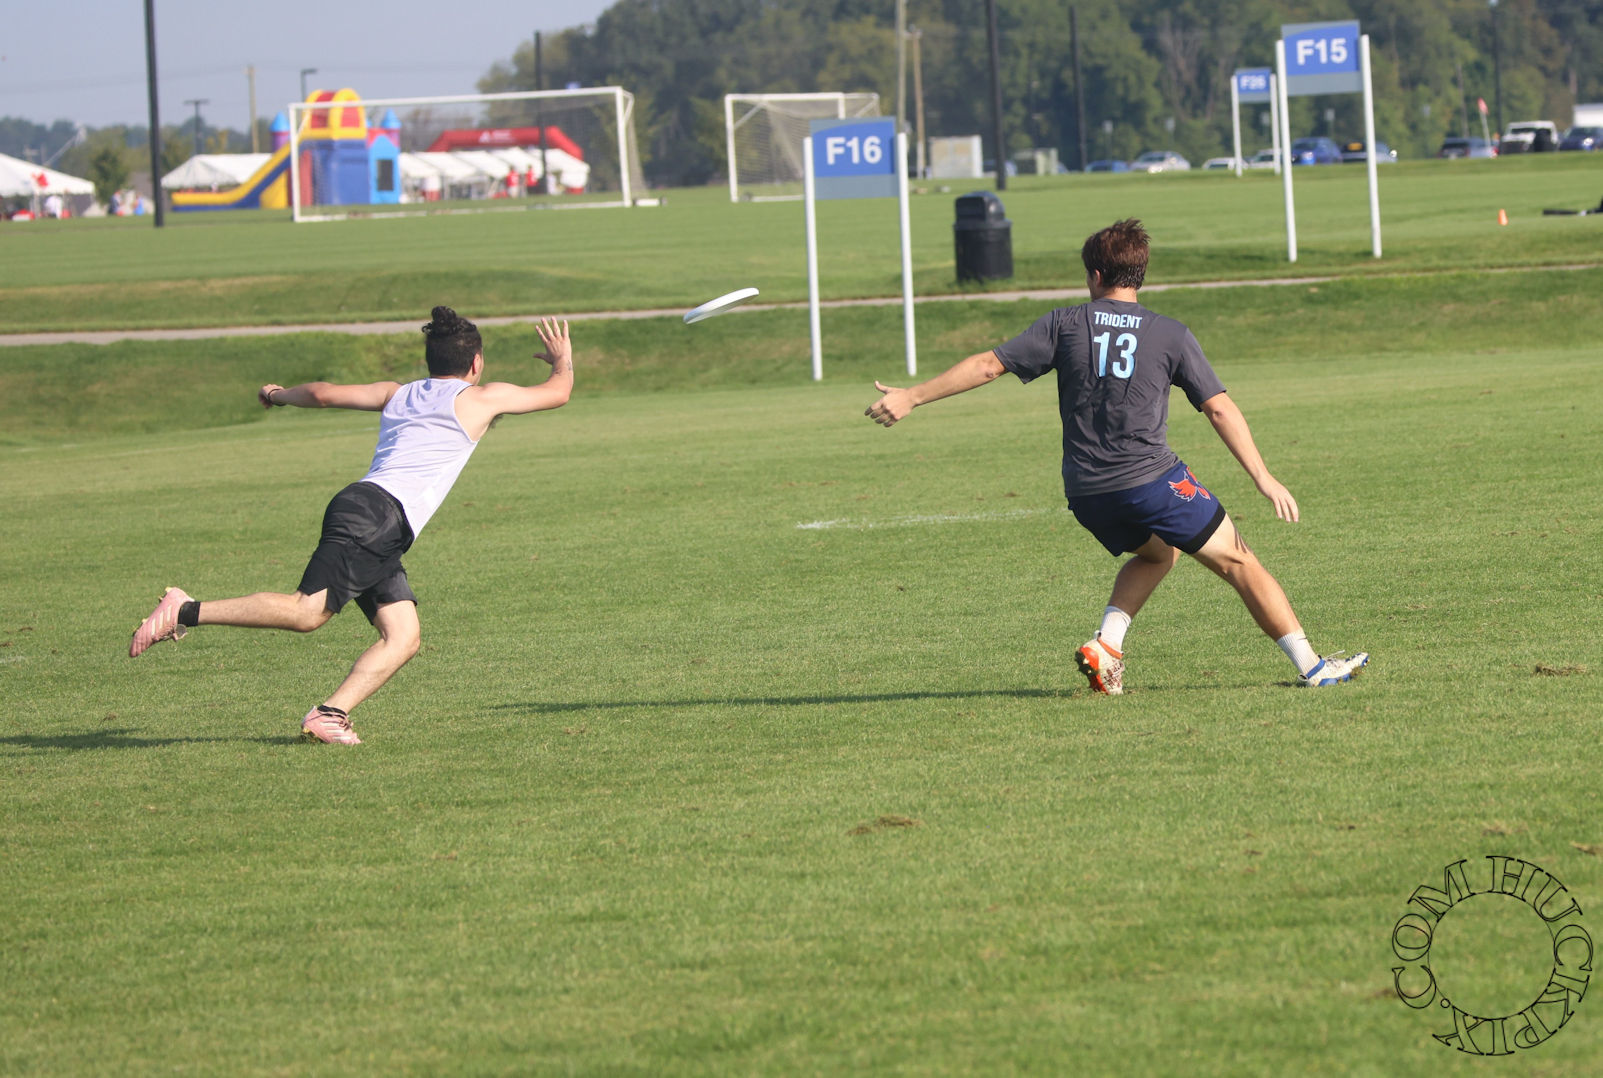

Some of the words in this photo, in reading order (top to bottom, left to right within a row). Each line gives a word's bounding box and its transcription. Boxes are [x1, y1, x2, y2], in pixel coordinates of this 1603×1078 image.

[1296, 37, 1348, 66] F15
[826, 135, 883, 166] F16
[1094, 311, 1143, 329] TRIDENT
[1093, 331, 1138, 379] 13
